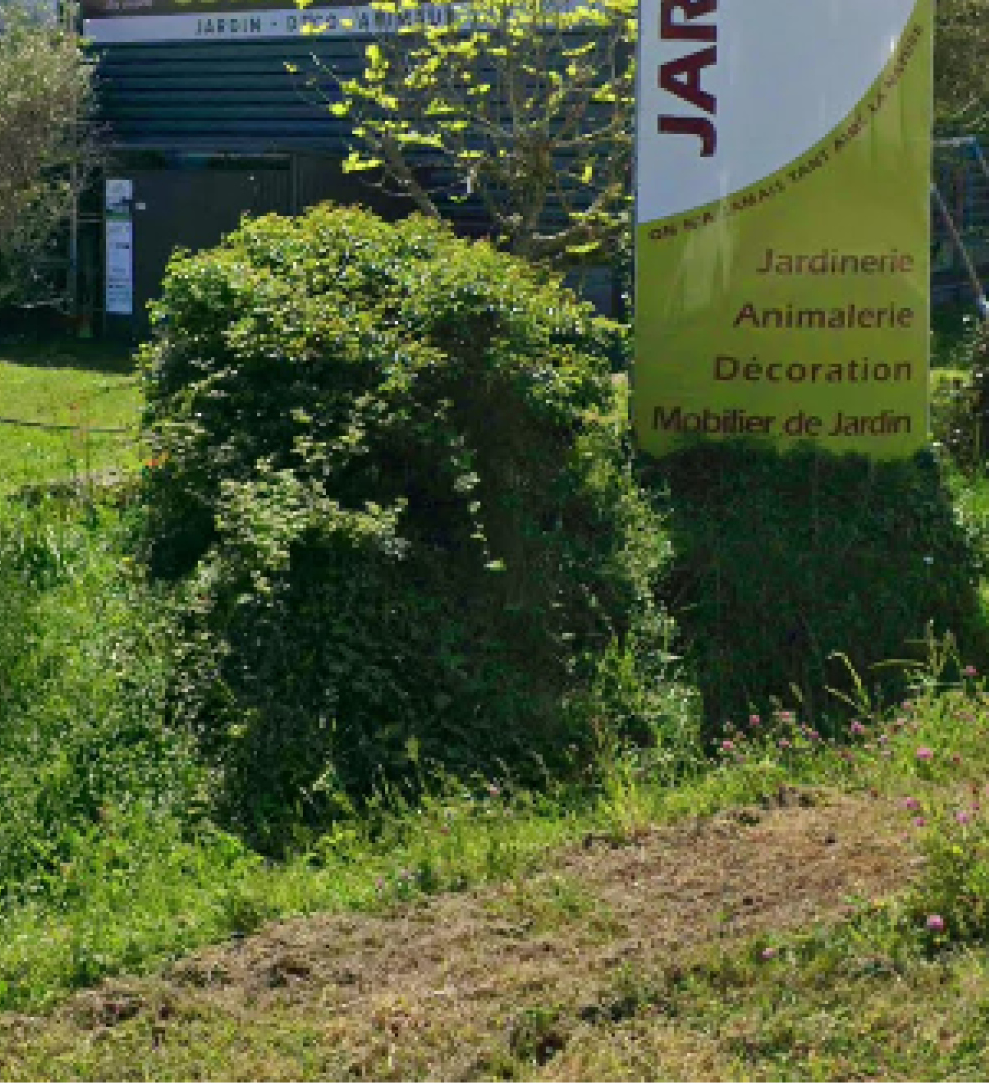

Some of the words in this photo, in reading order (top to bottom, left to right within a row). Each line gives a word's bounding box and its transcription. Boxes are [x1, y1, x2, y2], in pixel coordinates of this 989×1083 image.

[195, 18, 261, 35] JARDIN
[755, 248, 915, 275] Jardinerie
[733, 302, 915, 329] Animalerie
[713, 354, 912, 383] Décoration
[652, 406, 777, 434] Mobilier
[782, 409, 823, 437] de
[828, 409, 912, 437] Jardin
